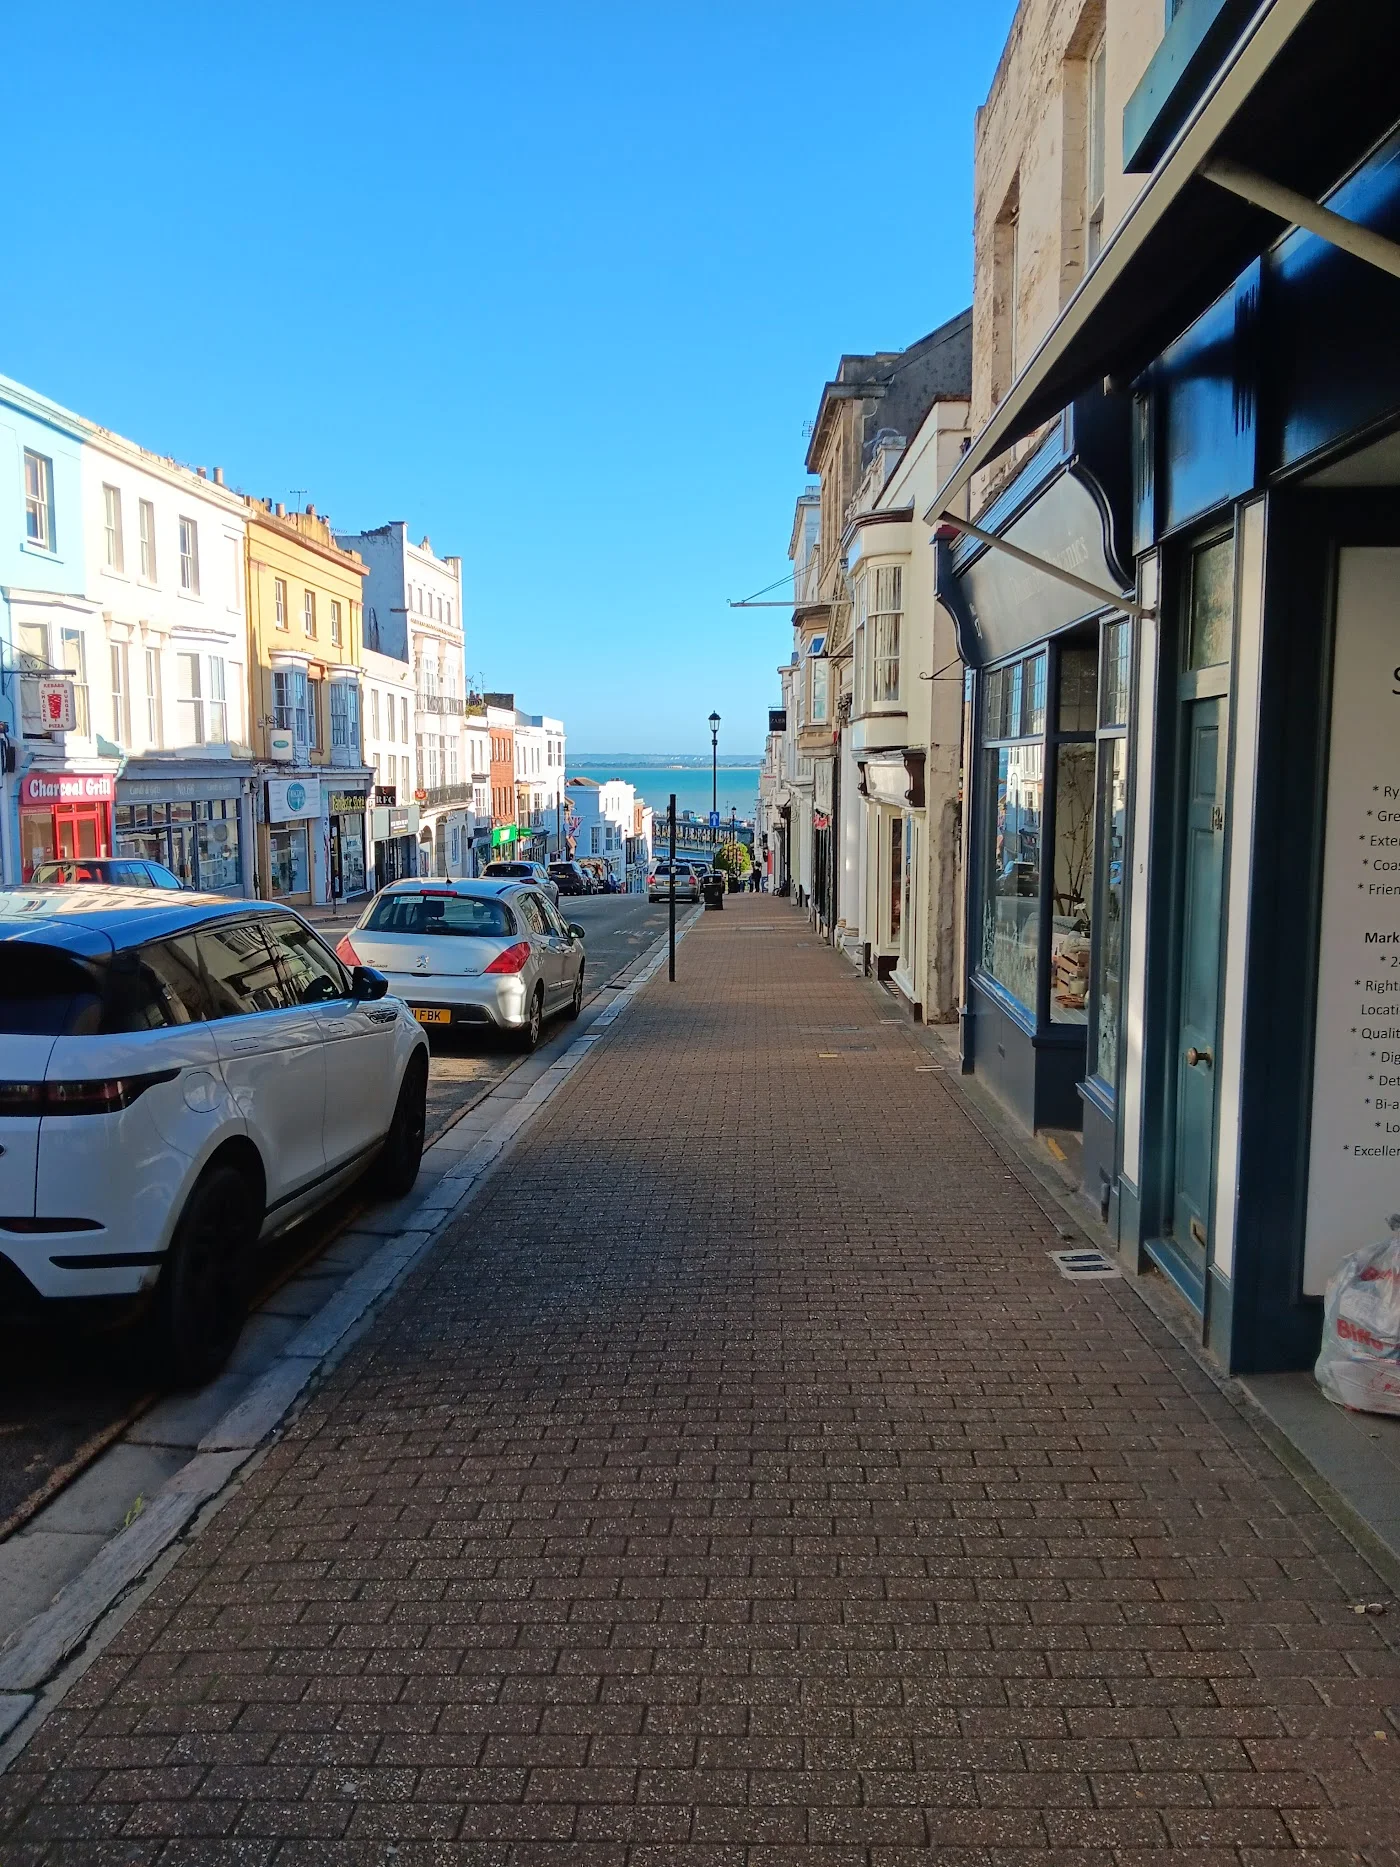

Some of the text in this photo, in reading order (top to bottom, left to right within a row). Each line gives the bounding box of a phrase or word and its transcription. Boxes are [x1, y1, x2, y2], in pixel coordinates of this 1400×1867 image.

[29, 778, 111, 797] Charcoal Grill
[376, 796, 395, 804] RFC
[1377, 811, 1400, 822] Gre
[1370, 835, 1400, 846] Exte
[1365, 932, 1400, 943] Mark
[1366, 980, 1400, 994] Right
[1361, 1004, 1400, 1015] Locati
[420, 1010, 441, 1021] FBK
